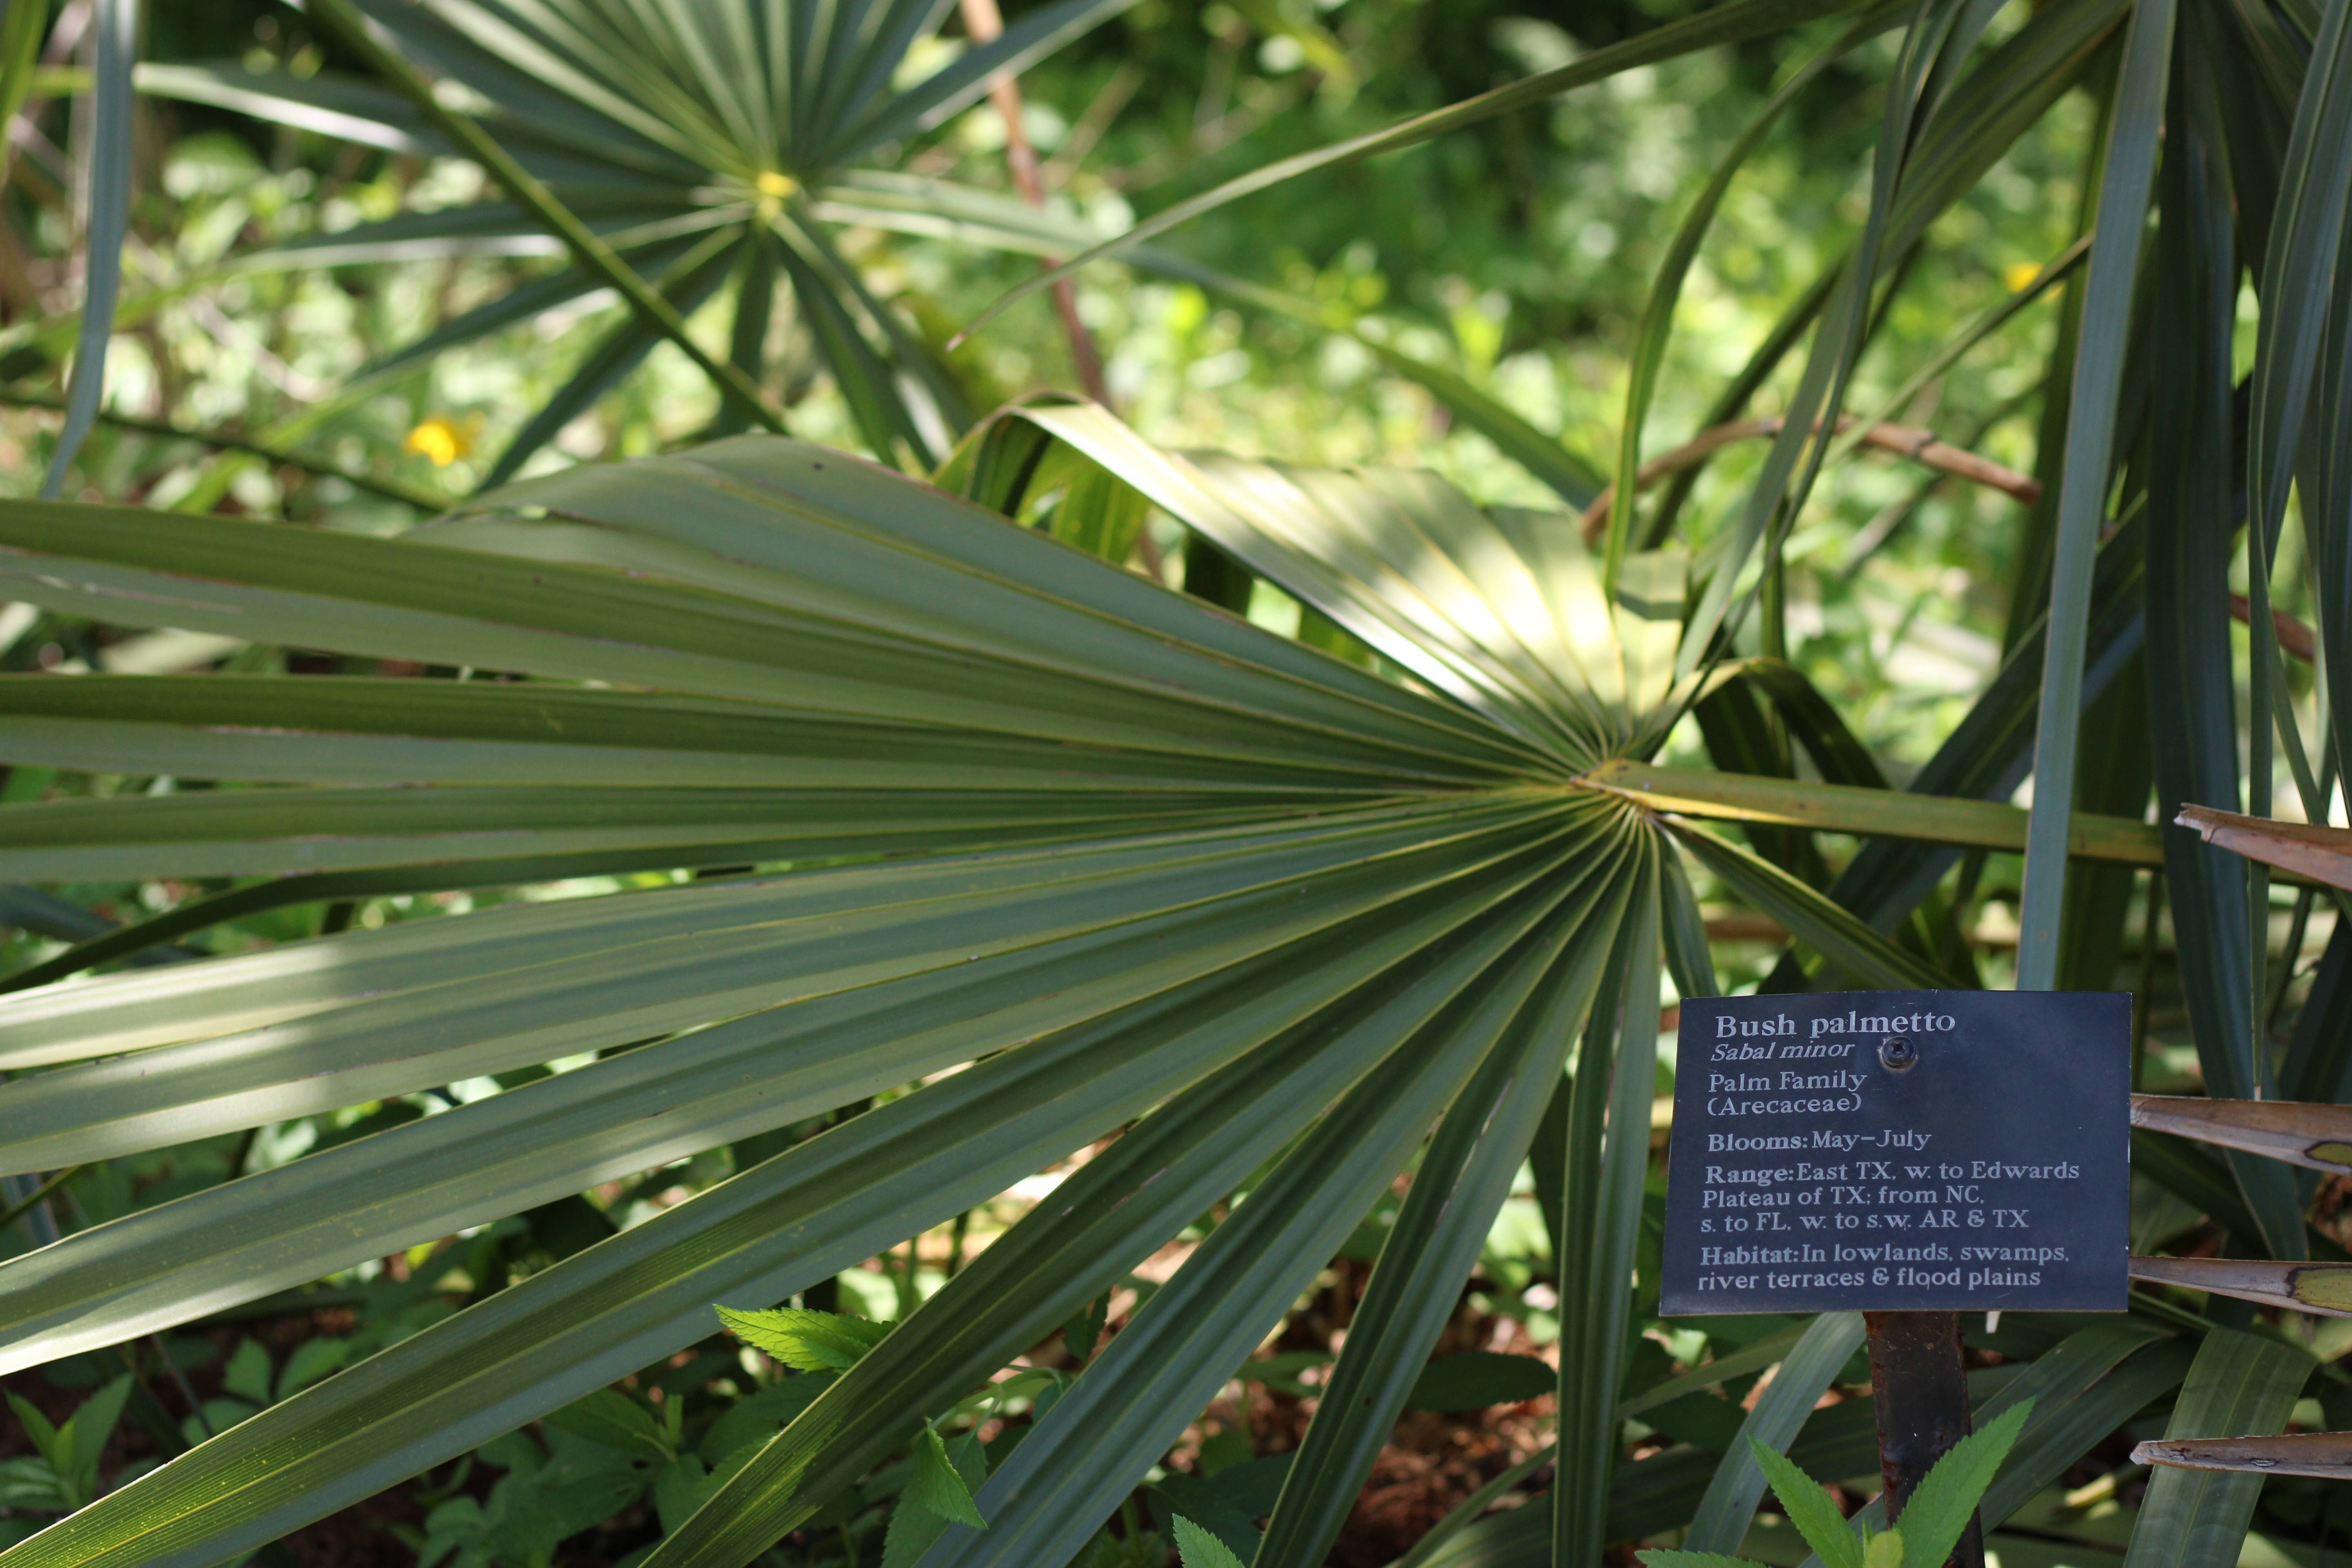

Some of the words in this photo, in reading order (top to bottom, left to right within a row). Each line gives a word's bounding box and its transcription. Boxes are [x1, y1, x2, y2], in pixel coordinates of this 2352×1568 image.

[1716, 1013, 1797, 1038] Bush
[1809, 1011, 1956, 1038] palmetto
[1711, 1042, 1776, 1061] Sabal
[1779, 1040, 1855, 1058] minor
[1709, 1073, 1771, 1092] Palm
[1779, 1070, 1867, 1091] Family
[1707, 1093, 1862, 1116] (Arecaceae)
[1796, 1163, 1848, 1181] East
[1939, 1163, 1964, 1178] to
[1971, 1161, 2080, 1179] Edwards
[1703, 1190, 1791, 1208] Plateau
[1798, 1187, 1823, 1205] of
[1878, 1186, 1938, 1203] from
[1725, 1215, 1748, 1232] to
[1835, 1213, 1859, 1229] to
[1919, 1210, 1960, 1228] AR
[1967, 1210, 1985, 1227] &
[1993, 1210, 2029, 1228] TX
[1802, 1244, 1826, 1262] In
[1698, 1272, 1759, 1290] river
[1767, 1271, 1865, 1289] terraces
[1872, 1267, 1890, 1285] &
[1897, 1268, 1960, 1286] flood
[1968, 1267, 2041, 1290] plains
